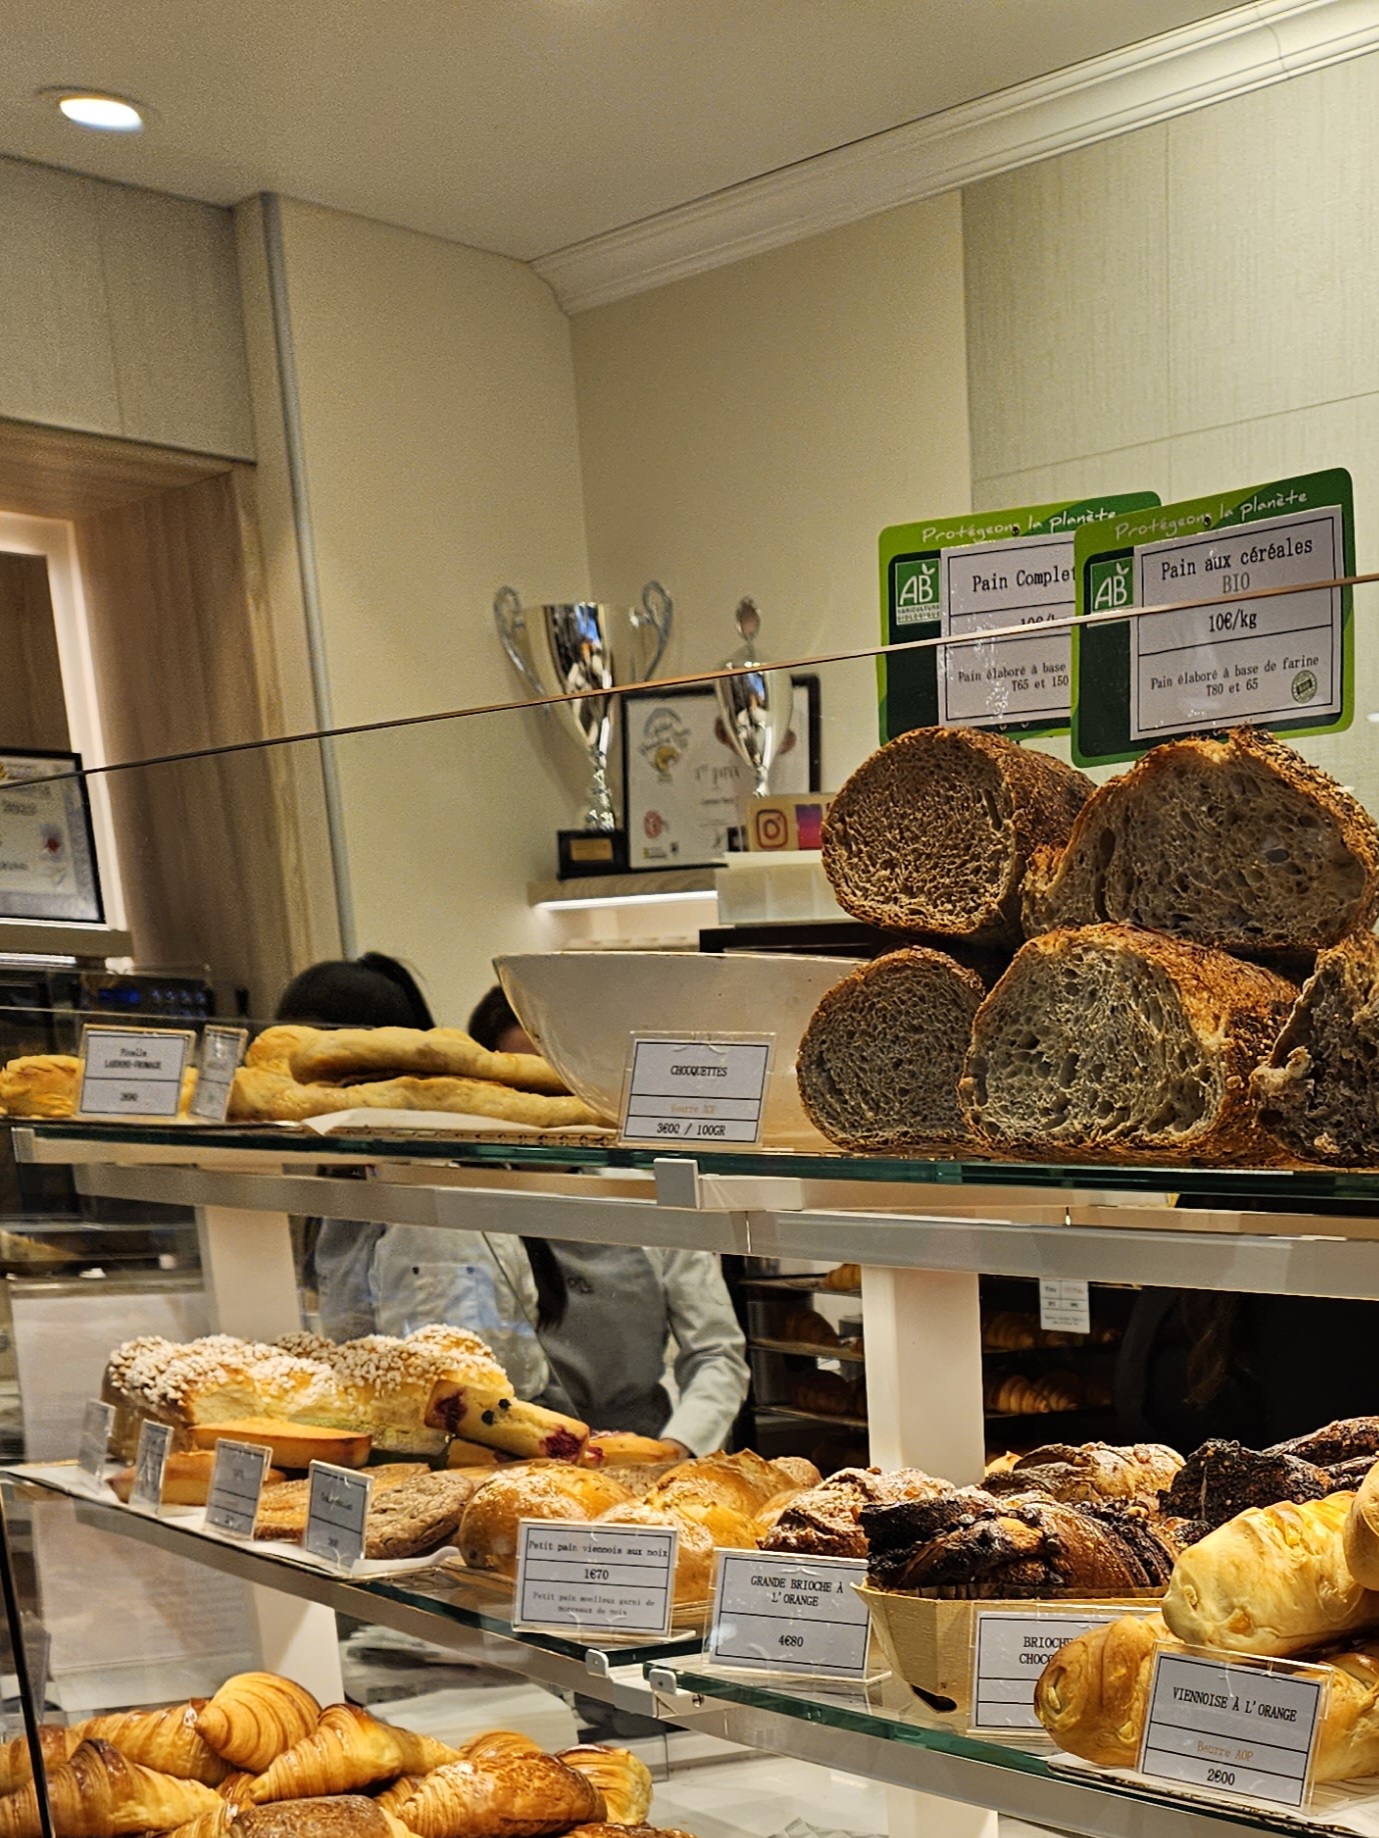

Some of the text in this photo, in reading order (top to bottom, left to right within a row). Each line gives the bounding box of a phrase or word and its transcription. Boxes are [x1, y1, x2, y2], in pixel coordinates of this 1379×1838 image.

[1220, 504, 1233, 519] la
[1240, 489, 1308, 521] planète
[1161, 537, 1313, 580] Pain aux céréales
[899, 575, 934, 606] AB
[973, 573, 1008, 592] Pain
[1094, 574, 1127, 609] AB
[1222, 572, 1250, 595] BIO
[1209, 608, 1258, 633] 10€/kg
[958, 662, 1066, 683] Pain élaboré à base
[1151, 655, 1319, 691] Pain élaboré à base de farine
[1012, 679, 1030, 692] T65
[1034, 678, 1046, 689] et
[1206, 677, 1259, 697] T80 et 65
[697, 1124, 726, 1136] 100GR
[529, 1540, 553, 1551] Petit
[557, 1543, 578, 1553] pain
[626, 1547, 642, 1556] aux
[647, 1548, 668, 1558] noix
[584, 1568, 609, 1580] 1€70
[751, 1575, 787, 1588] GRANDE
[790, 1578, 832, 1592] BRIOCHE
[778, 1635, 804, 1647] 4€80
[1172, 1687, 1229, 1710] VIENNOISE
[1231, 1696, 1241, 1711] À
[1207, 1769, 1236, 1786] 2€00
